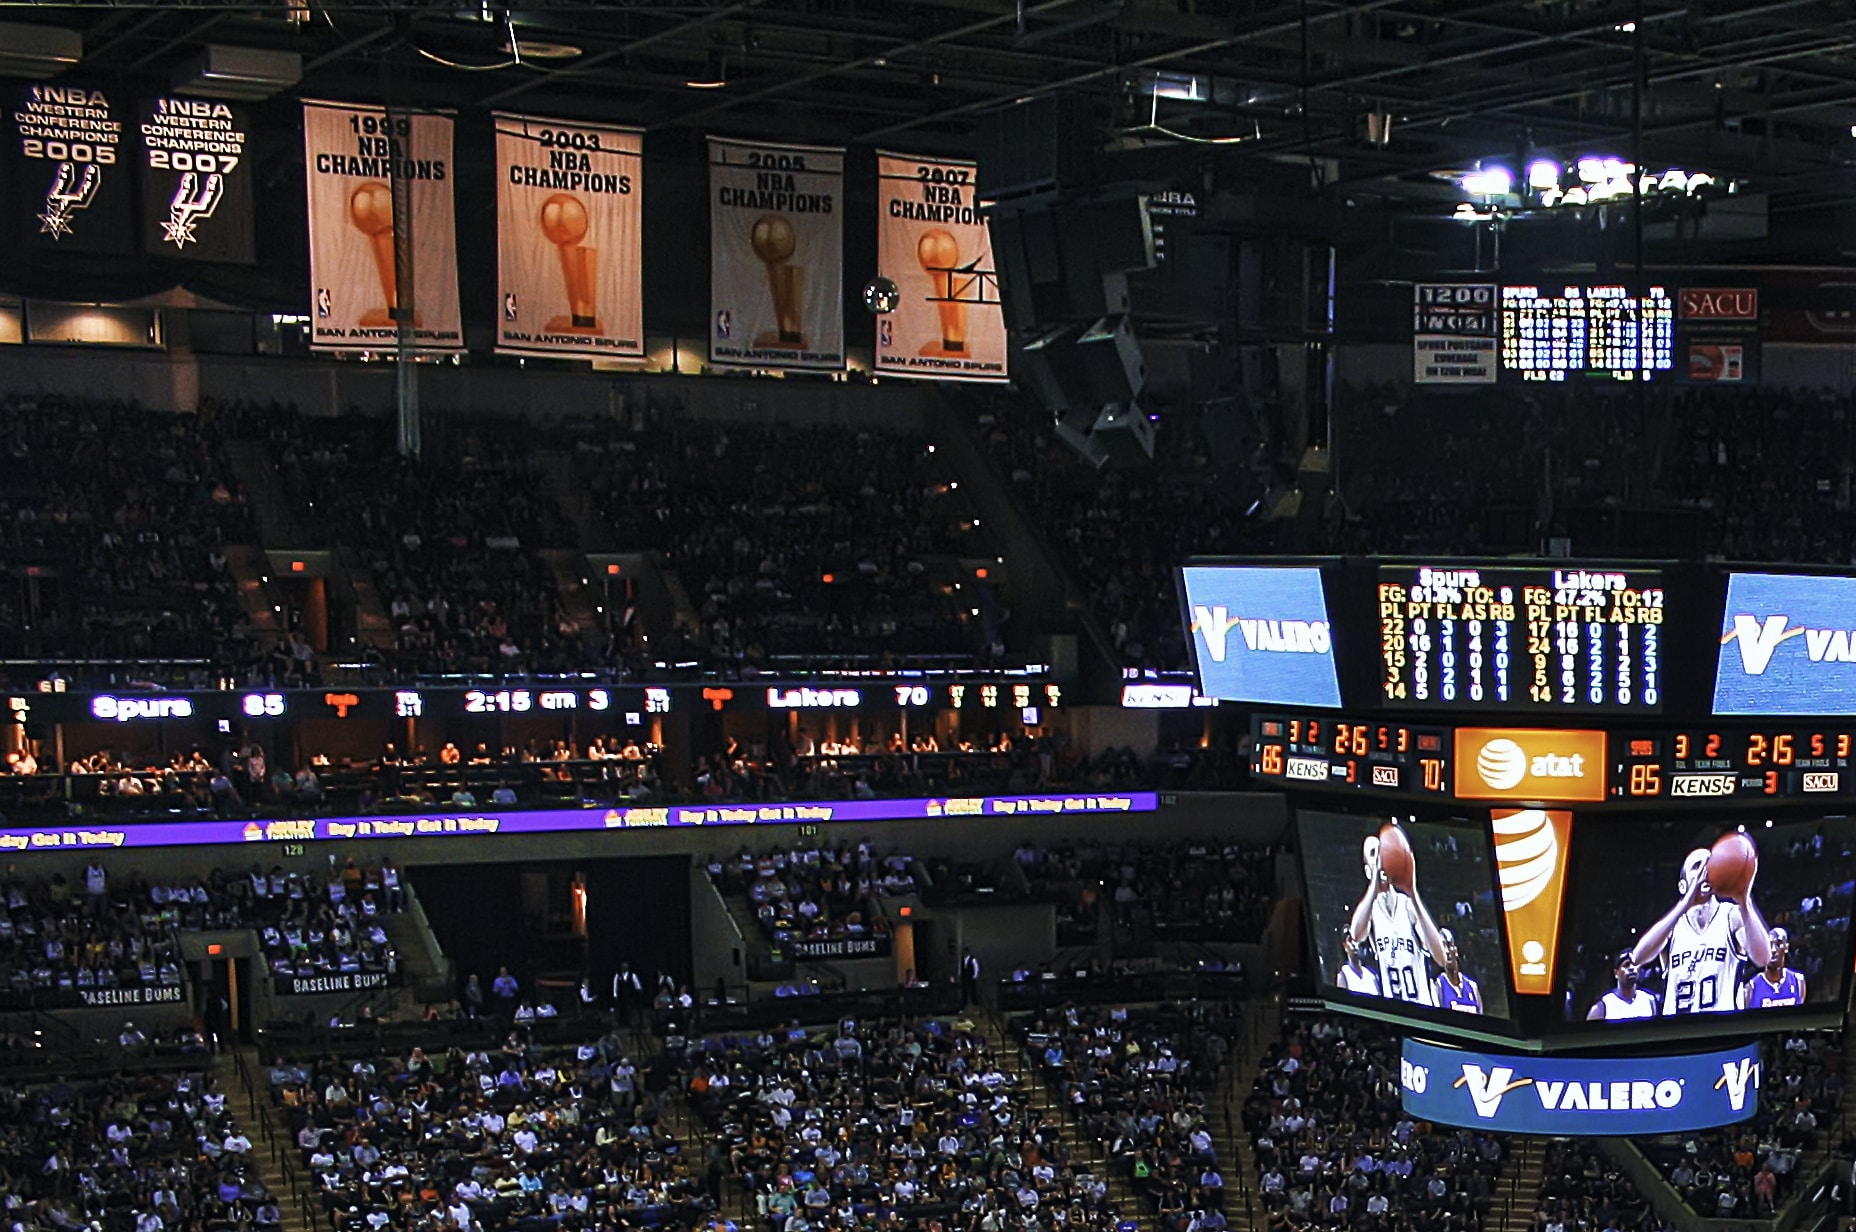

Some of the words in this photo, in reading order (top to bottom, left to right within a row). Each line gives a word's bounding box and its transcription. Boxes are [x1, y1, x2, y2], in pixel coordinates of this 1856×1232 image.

[44, 87, 110, 108] NBA
[27, 102, 108, 119] WESTERN
[170, 100, 232, 118] NBA
[15, 112, 122, 132] CONFERENCE
[153, 115, 232, 130] WESTERN
[19, 126, 119, 143] CHAMPIONS
[141, 124, 245, 143] CONFERENCE
[540, 129, 600, 150] 2003
[23, 139, 116, 165] 2005
[145, 137, 242, 154] CHAMPIONS
[150, 150, 239, 174] 2007
[550, 151, 591, 172] NBA
[510, 165, 631, 194] CHAMPIONS
[757, 172, 796, 192] NBA
[720, 187, 832, 213] CHAMPIONS
[925, 185, 961, 205] NBA
[1423, 288, 1489, 303] 1200
[1683, 293, 1752, 315] SACU
[1420, 568, 1480, 590] Spurs
[1554, 570, 1627, 590] Lakers
[1380, 586, 1406, 602] FG:
[1464, 588, 1494, 603] TO:
[1500, 587, 1513, 604] 9
[1524, 588, 1551, 605] FG:
[1611, 590, 1641, 607] TO:
[1642, 589, 1664, 607] 12
[1381, 602, 1404, 619] PL
[1409, 603, 1431, 619] PT
[1437, 603, 1457, 620] FL
[1461, 603, 1487, 620] AS
[1490, 604, 1515, 621] RB
[1528, 605, 1551, 621] PL
[1556, 606, 1579, 621] PT
[1585, 606, 1606, 622] FL
[1610, 606, 1635, 623] AS
[1637, 607, 1663, 624] RB
[1240, 618, 1330, 653] VALERO
[466, 690, 532, 712] 2:15
[769, 687, 860, 708] Lakers
[896, 687, 929, 706] 70
[93, 695, 193, 721] Spurs
[244, 695, 285, 716] 85
[1374, 768, 1397, 784] SACU
[1419, 759, 1441, 791] 70
[1631, 764, 1661, 795] 85
[1806, 775, 1835, 789] SACU
[848, 939, 876, 954] BUMS
[1671, 947, 1727, 970] SPURS
[293, 975, 349, 993] BASELINE
[354, 973, 388, 989] BUMS
[1677, 974, 1717, 1009] 20
[145, 987, 181, 1002] BUMS
[1535, 1079, 1683, 1111] VALERO
